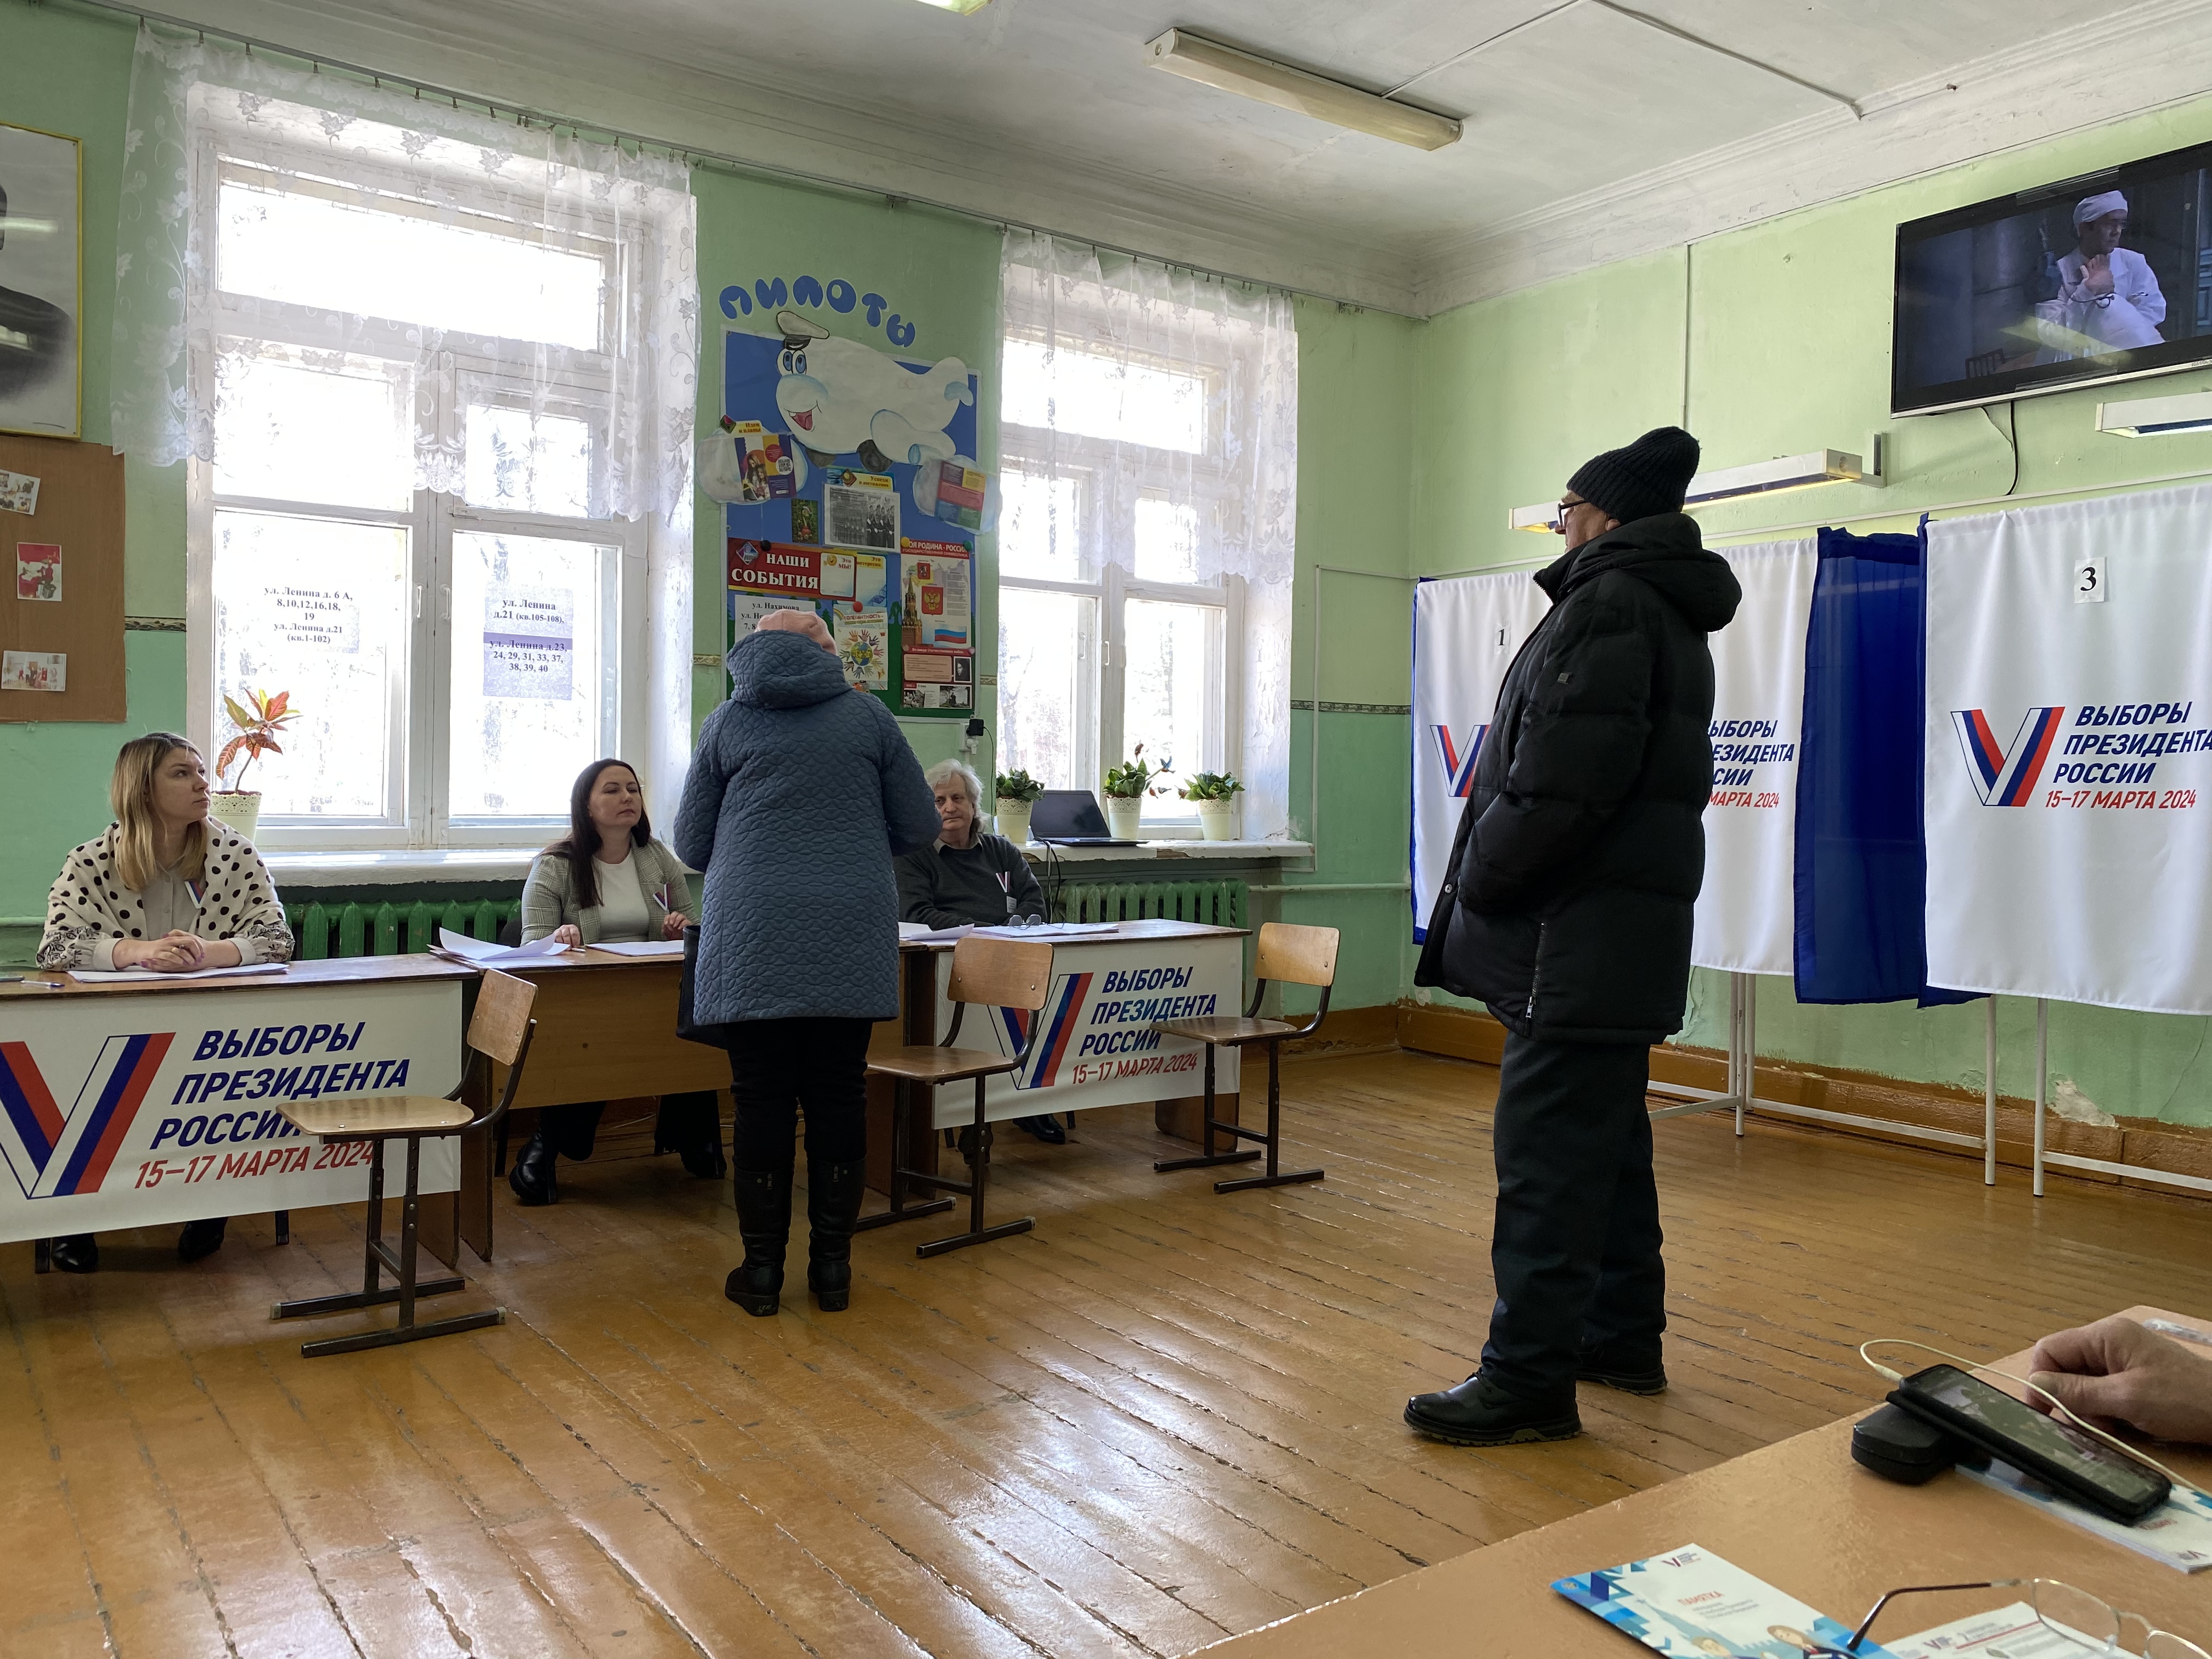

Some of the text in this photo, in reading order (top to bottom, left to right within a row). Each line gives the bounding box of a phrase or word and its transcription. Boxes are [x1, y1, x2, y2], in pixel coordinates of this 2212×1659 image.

[918, 541, 942, 550] РОДИНА
[766, 553, 810, 568] НАШИ
[731, 568, 819, 590] СОБЫТИЯ
[2080, 567, 2097, 591] 3
[263, 588, 279, 596] ул.
[282, 586, 320, 597] Ленина
[342, 592, 353, 601] А,
[276, 598, 341, 612] 8,10,12,16,18,
[503, 599, 556, 610] ул. Ленина
[304, 612, 314, 620] 19
[493, 610, 513, 619] д.21
[274, 623, 287, 631] ул.
[290, 623, 324, 632] Ленина
[744, 623, 751, 631] 7,
[287, 633, 331, 644] (кв.1-102)
[1498, 628, 1506, 646] 1
[489, 640, 567, 653] ул. Ленина д.23,
[493, 651, 563, 664] 24, 29, 31, 33, 37,
[509, 663, 549, 673] 38, 39, 40
[2074, 701, 2193, 727] ВЫБОРЫ
[1709, 720, 1778, 738] ЫБОРЫ
[1713, 743, 1795, 765] ЕЗИДЕНТА
[1713, 768, 1754, 786] СИИ
[2053, 762, 2157, 784] РОССИИ
[1709, 791, 1780, 808] МАРТА 2024
[2091, 790, 2154, 809] МАРТА
[2158, 789, 2196, 809] 2024
[1102, 966, 1194, 994] ВЫБОРЫ
[1090, 994, 1217, 1025] ПРЕЗИДЕНТА
[192, 1022, 366, 1061] ВЫБОРЫ
[1079, 1029, 1162, 1057] РОССИИ
[1114, 1056, 1164, 1079] МАРТА
[1163, 1052, 1199, 1073] 2024
[171, 1059, 410, 1105] ПРЕЗИДЕНТА
[216, 1146, 311, 1181] МАРТА
[313, 1141, 374, 1170] 2024
